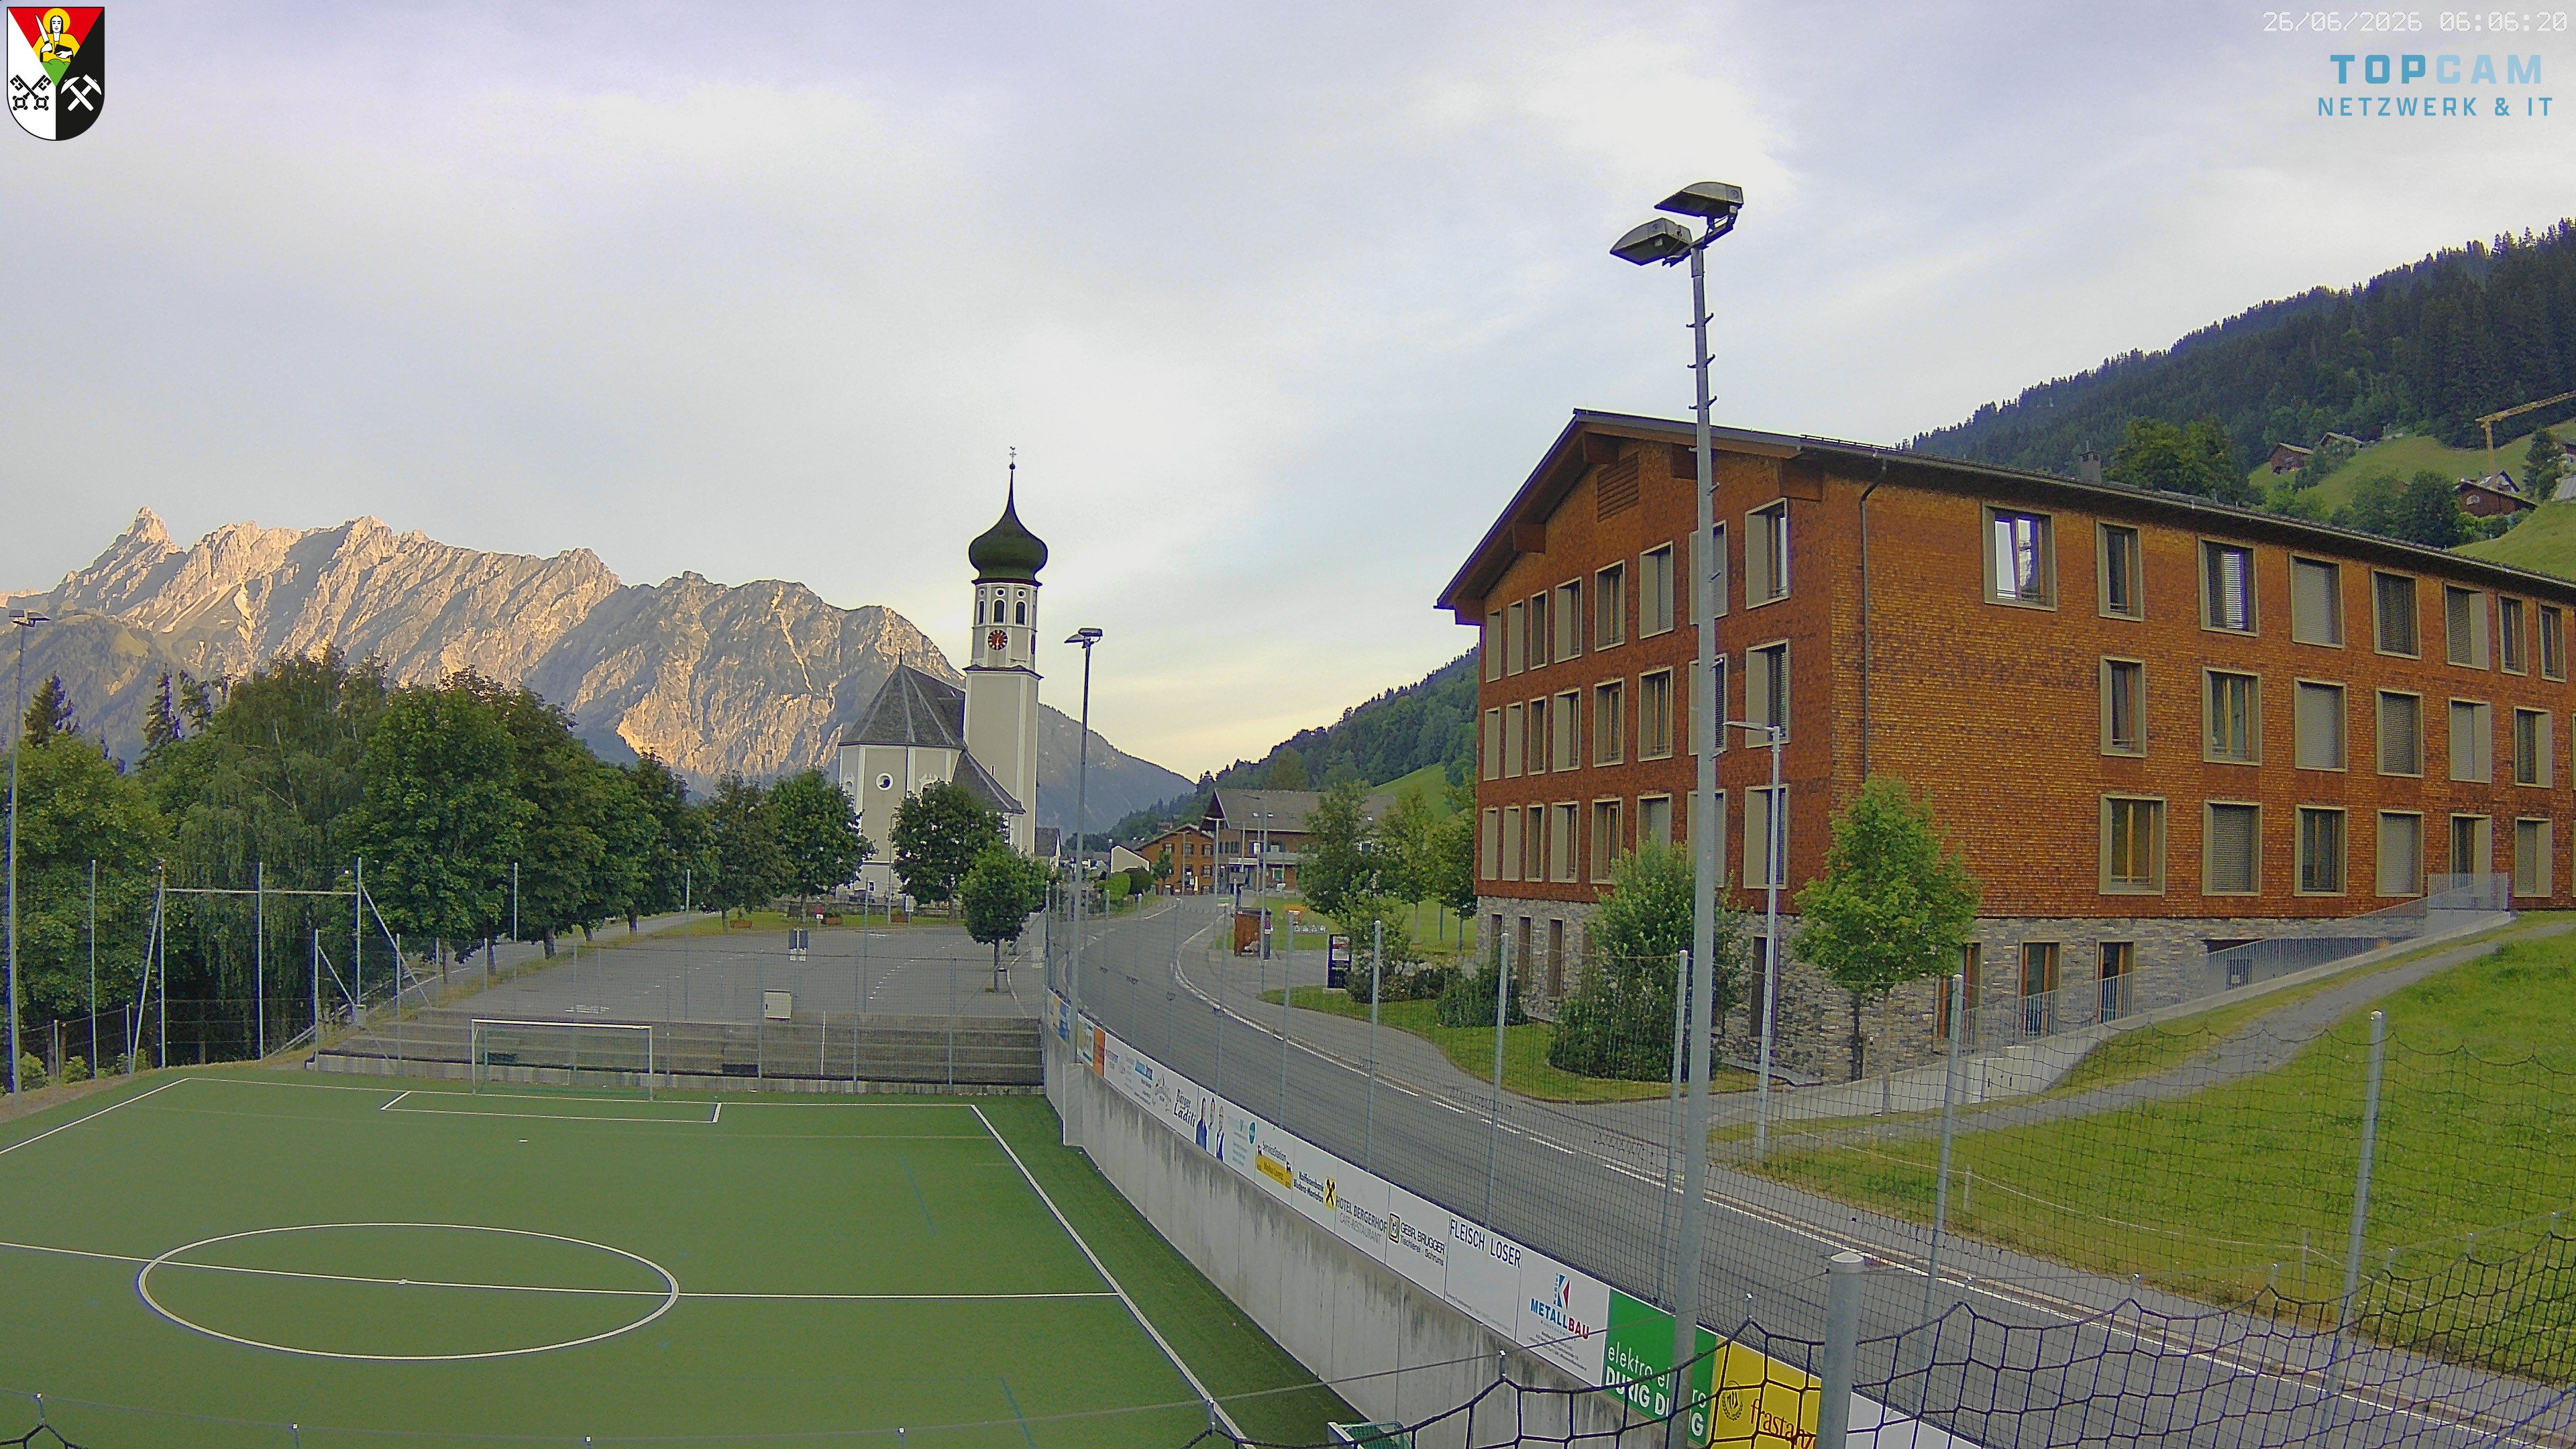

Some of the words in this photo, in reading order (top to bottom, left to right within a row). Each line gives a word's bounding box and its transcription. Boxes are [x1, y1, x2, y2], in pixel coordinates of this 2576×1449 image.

[1299, 1171, 1324, 1192] Raiffeisenbank
[1336, 1195, 1352, 1215] HOTEL
[1353, 1205, 1388, 1234] BERGERHOF
[1424, 1248, 1444, 1267] Schruns
[1449, 1218, 1485, 1252] FLEISCH
[1489, 1236, 1521, 1269] LOSER
[1530, 1298, 1590, 1340] METALLBAU
[1607, 1341, 1652, 1377] elektro
